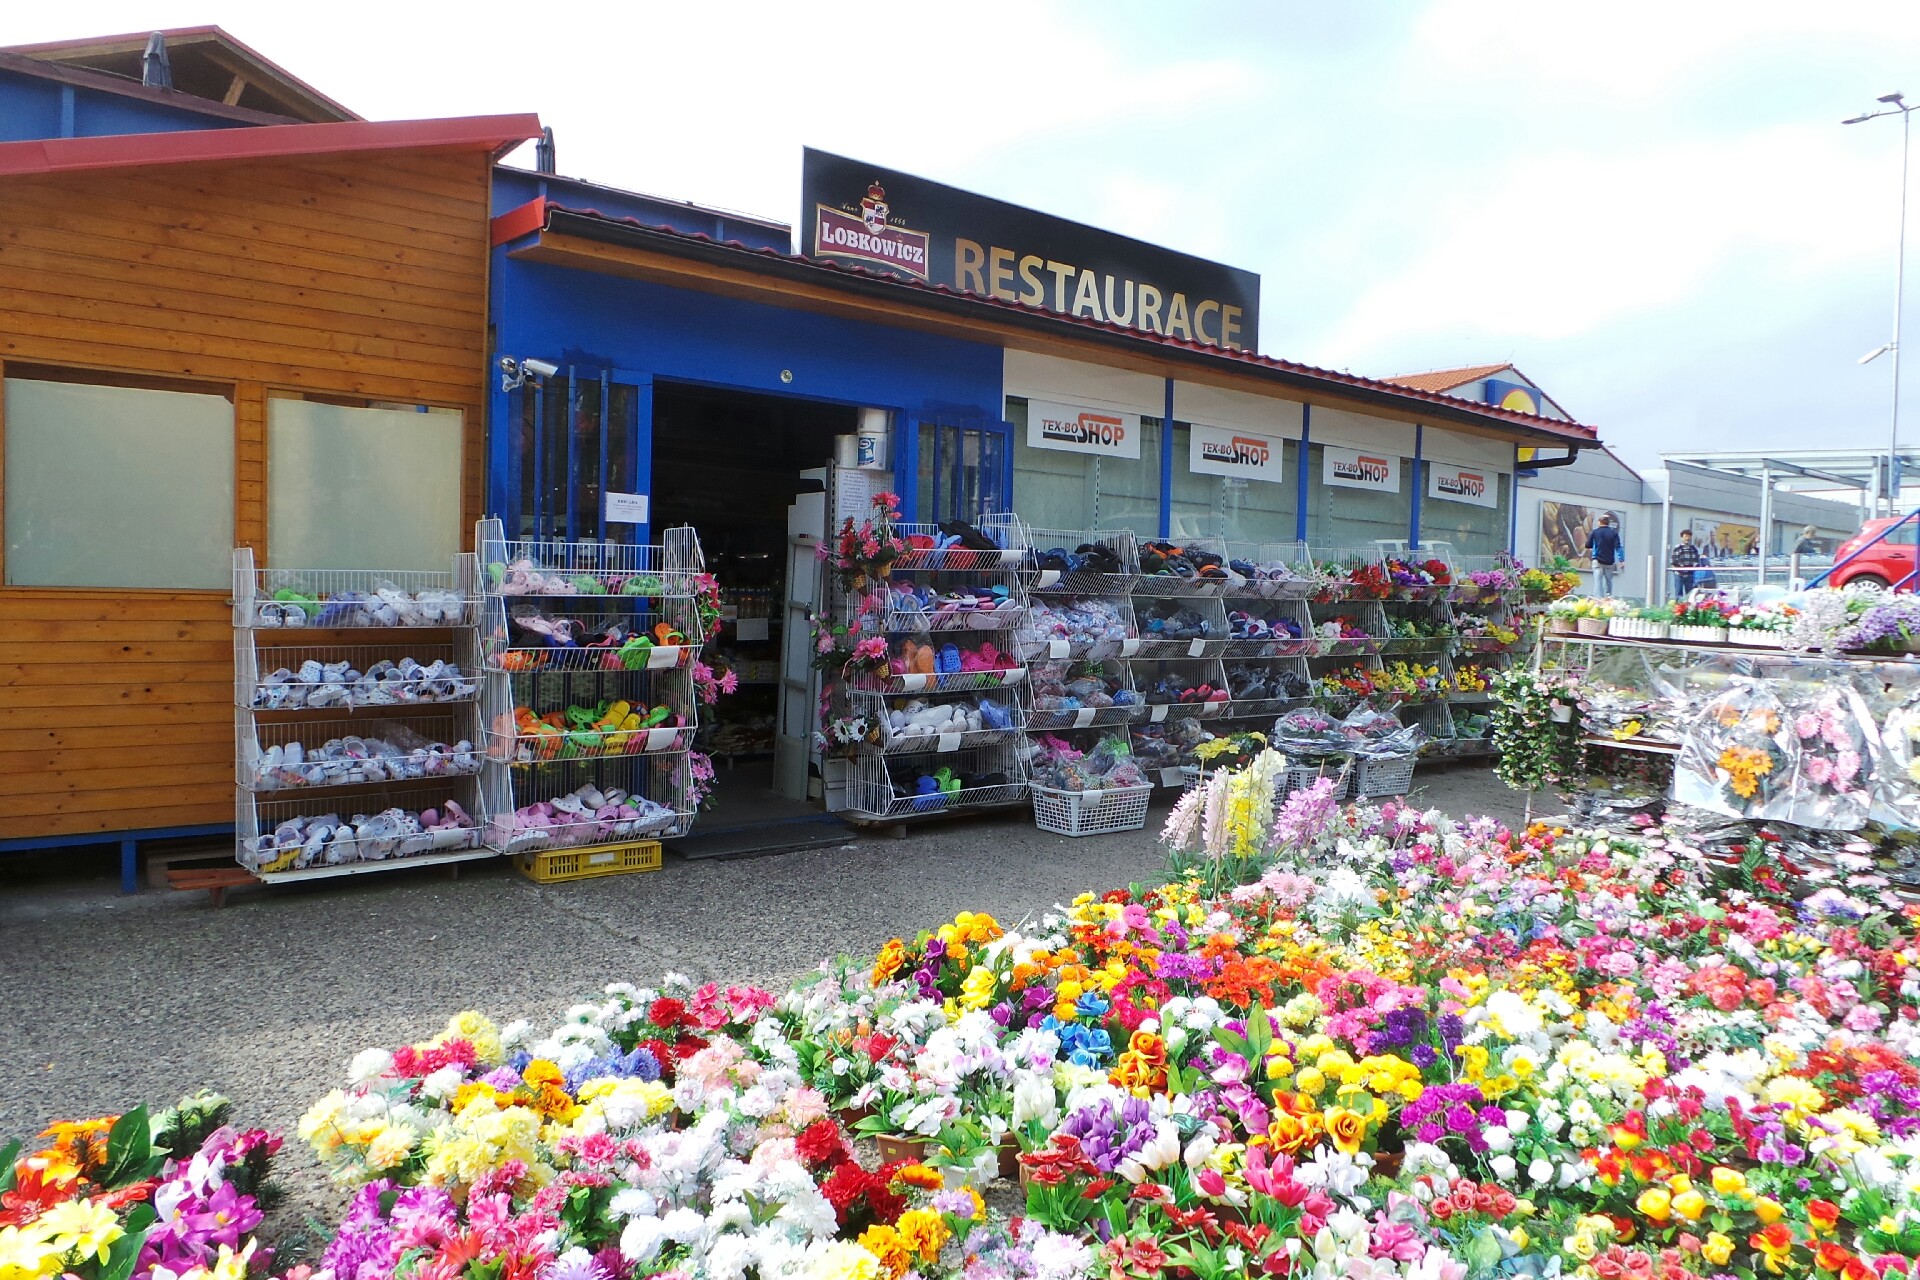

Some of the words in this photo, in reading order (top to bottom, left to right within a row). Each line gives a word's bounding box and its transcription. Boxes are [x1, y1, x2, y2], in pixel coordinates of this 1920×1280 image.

[822, 221, 924, 264] LOBKOWICZ
[955, 237, 1243, 351] RESTAURACE
[1042, 419, 1079, 434] TEX-BO
[1077, 412, 1125, 447] SHOP
[1202, 442, 1232, 456] TEX-BO
[1231, 435, 1269, 467] SHOP
[1333, 461, 1359, 474] TEX-BO
[1357, 455, 1389, 483] SHOP
[1457, 471, 1485, 498] SHOP
